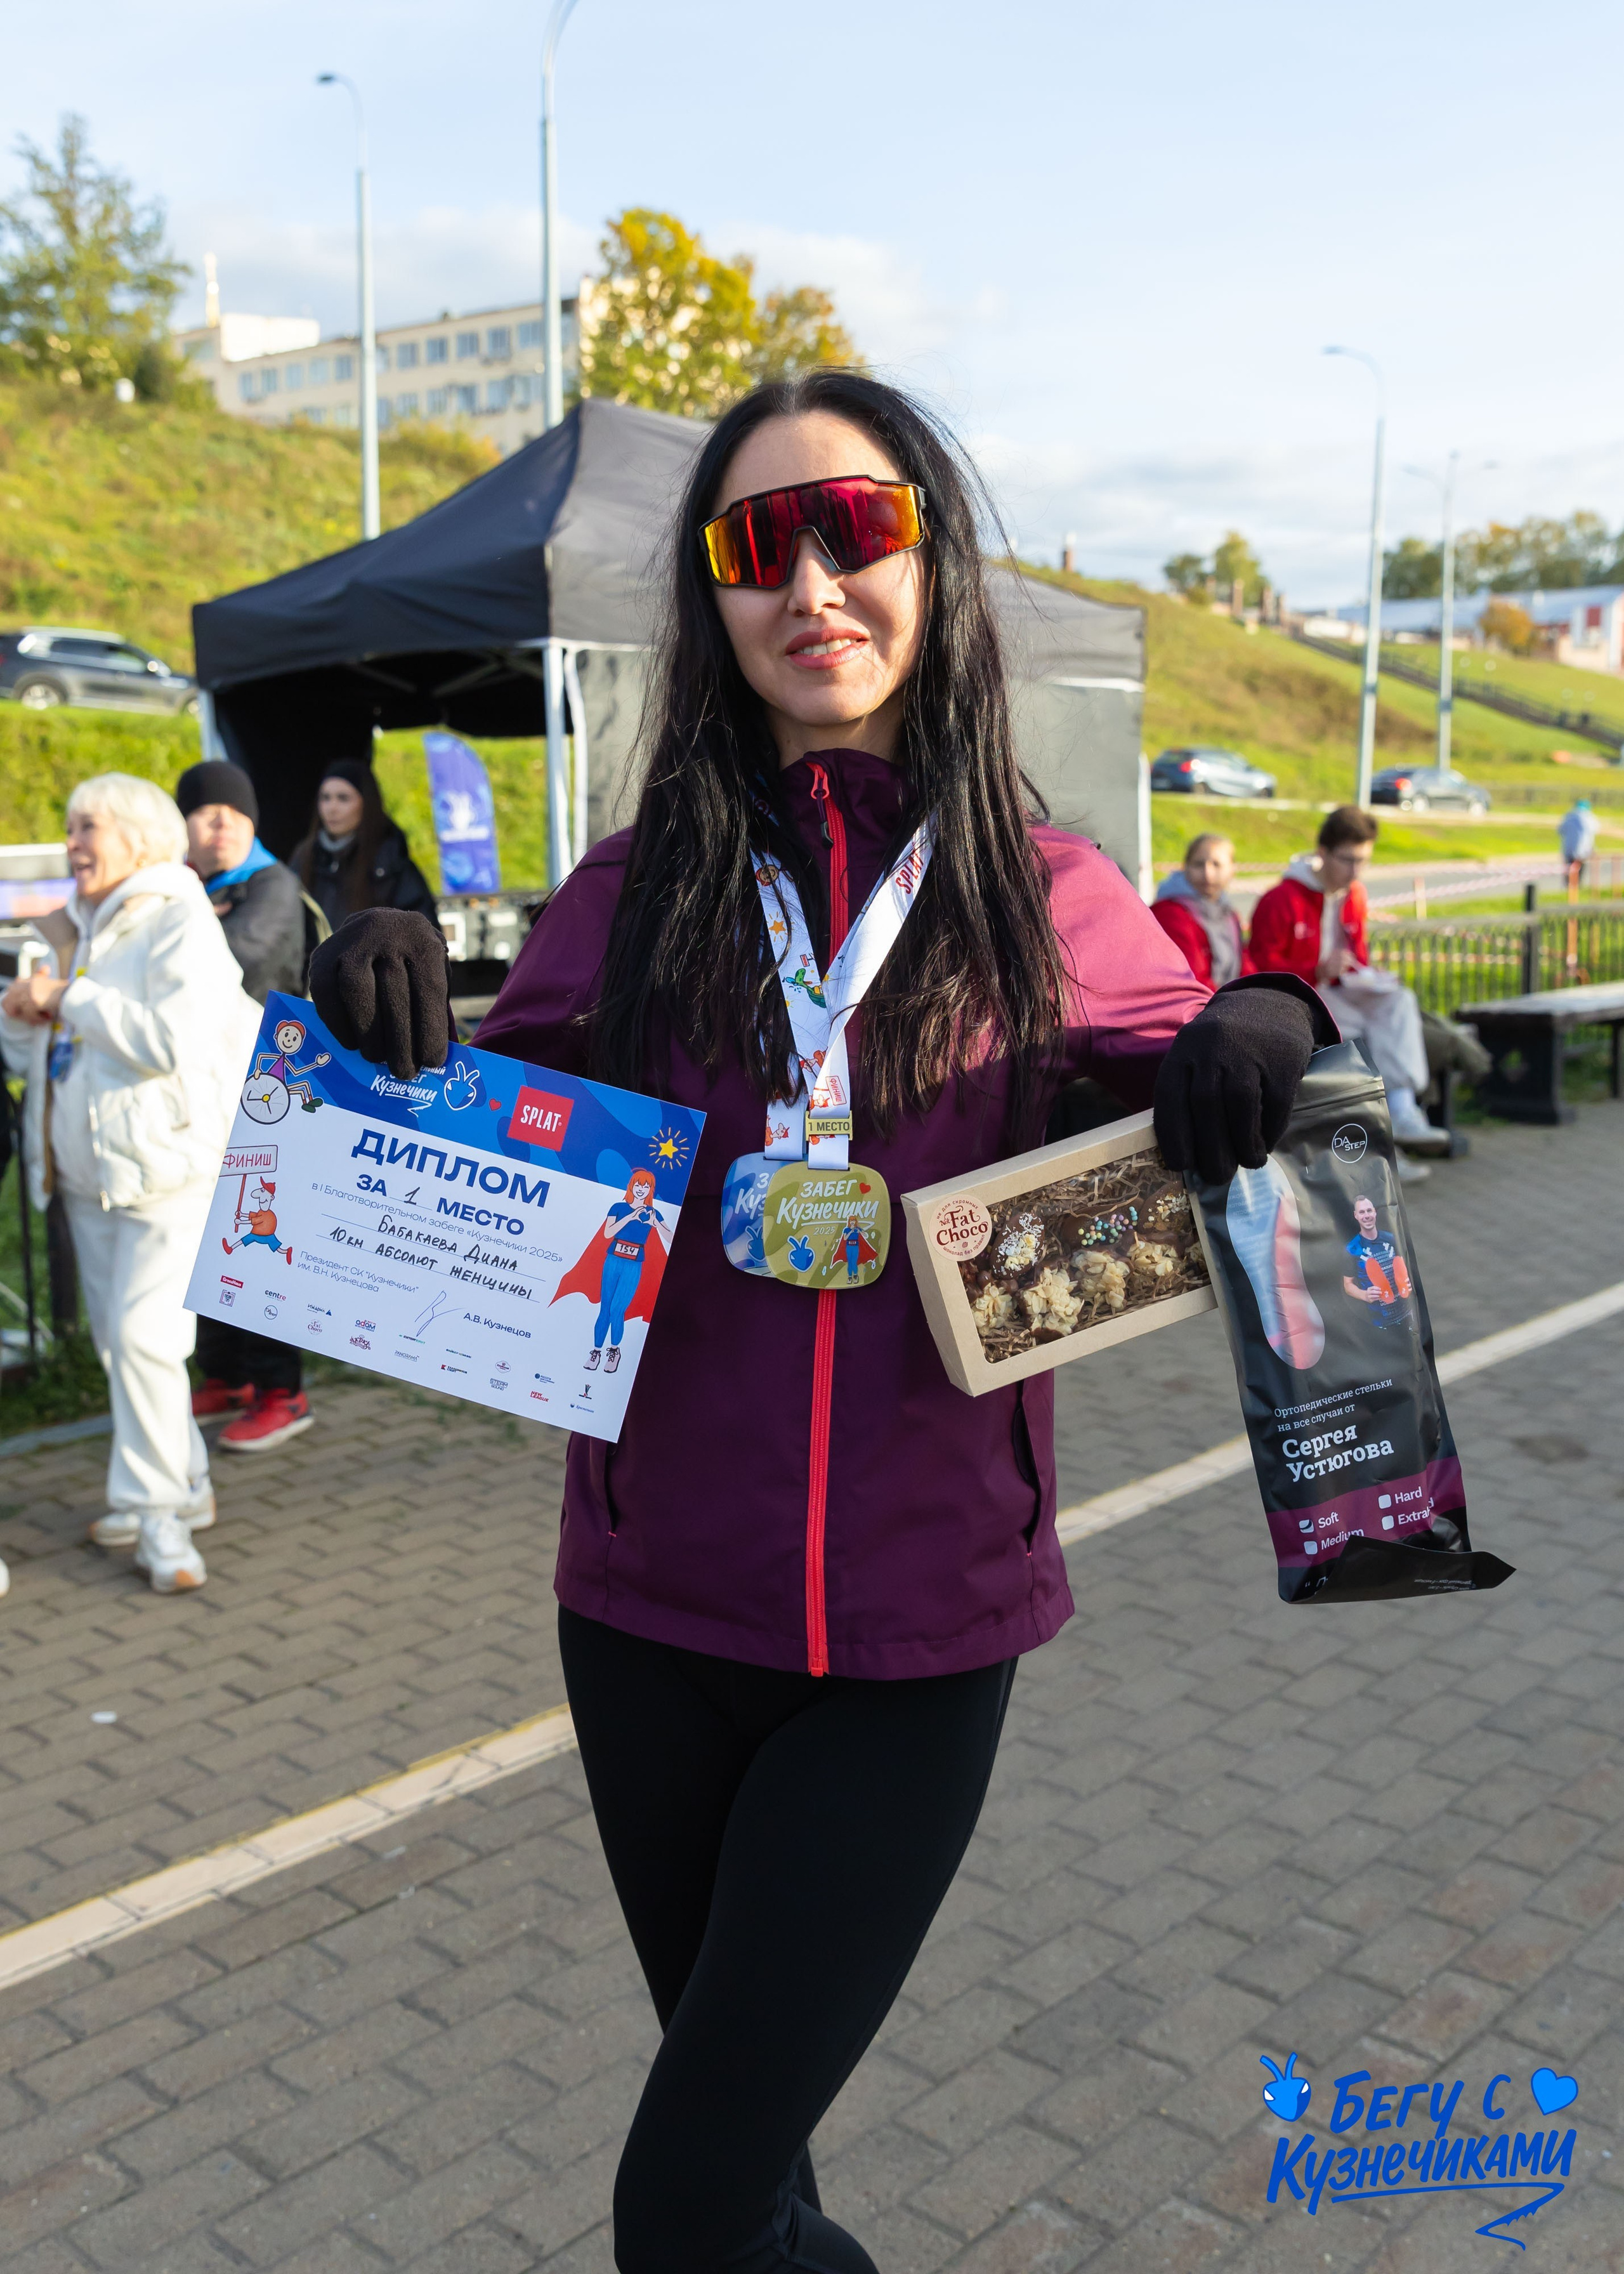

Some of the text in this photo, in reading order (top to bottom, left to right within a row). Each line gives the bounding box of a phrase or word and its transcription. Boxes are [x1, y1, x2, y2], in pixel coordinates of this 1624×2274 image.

[370, 1074, 438, 1102] Кузнечики
[808, 1122, 850, 1131] 1 МЕСТО
[1345, 1141, 1366, 1151] STEP
[222, 1153, 272, 1169] ФИНИШ
[351, 1128, 551, 1208] ДИПЛОМ
[800, 1179, 858, 1198] ЗАБЕГ
[356, 1174, 525, 1236] ЗА 1 МЕСТО
[776, 1197, 879, 1230] Кузнечики
[941, 1203, 951, 1213] для
[952, 1199, 979, 1209] скромных
[324, 1185, 428, 1225] Благотворительном
[428, 1218, 465, 1235] забеге
[466, 1228, 528, 1254] «Кузнечики
[529, 1245, 563, 1263] 2025»
[944, 1205, 981, 1230] Fat
[813, 1226, 836, 1236] 2025
[936, 1221, 989, 1245] Choco
[620, 1244, 636, 1254] 154
[943, 1246, 964, 1256] шоколад
[973, 1234, 985, 1251] правил
[299, 1251, 349, 1273] Президент
[350, 1266, 364, 1277] СК
[297, 1261, 380, 1293] им. В.Н. Кузнецова
[265, 1289, 287, 1301] centre
[463, 1311, 532, 1339] А.В. Кузнецов
[394, 1350, 418, 1361] PANORAMA
[530, 1393, 549, 1402] LEAGUE
[1274, 1379, 1393, 1419] Ортопедические стельки
[1278, 1403, 1356, 1432] на все случаи от
[1282, 1424, 1358, 1458] Сергея
[1286, 1440, 1394, 1483] Устюгова
[1394, 1486, 1423, 1504] Hard
[1318, 1511, 1340, 1528] Soft
